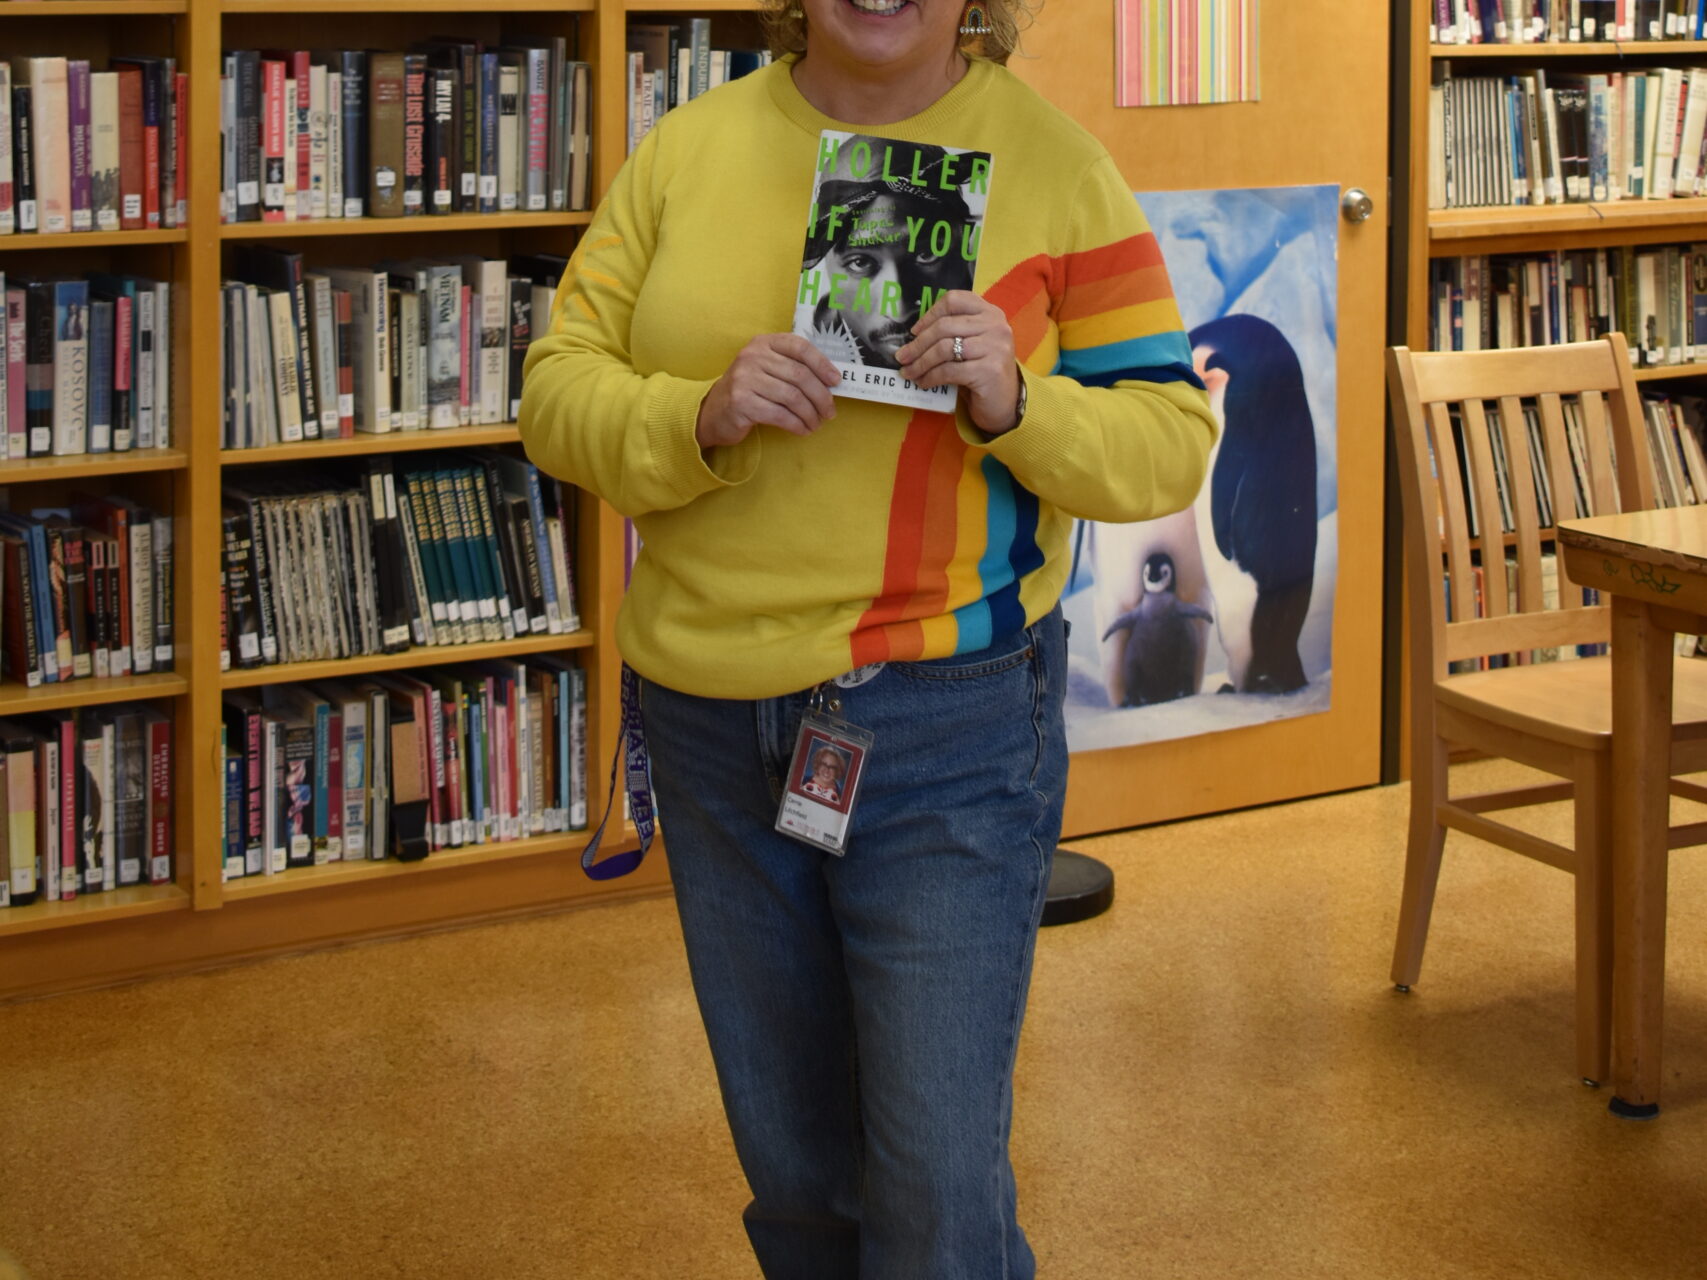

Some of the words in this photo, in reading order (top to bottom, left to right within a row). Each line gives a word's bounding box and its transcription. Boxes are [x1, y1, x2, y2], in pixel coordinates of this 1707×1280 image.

[272, 64, 280, 98] CHARLIE
[406, 72, 424, 95] The
[436, 80, 452, 96] MY
[697, 46, 708, 96] ENDURIN
[406, 97, 424, 122] Lost
[436, 97, 452, 112] LAI
[644, 78, 652, 107] TRAIL
[272, 100, 280, 134] WILSON'S
[528, 93, 548, 171] BACKFIRE
[272, 135, 280, 152] WAR
[406, 125, 424, 176] Crusade
[818, 136, 990, 195] HOLLER
[808, 203, 848, 241] IF
[906, 216, 981, 261] YOU
[296, 283, 306, 327] VIETNAM
[377, 278, 386, 332] Homecoming
[440, 273, 450, 323] VIETNAM
[799, 269, 902, 318] HEAR
[919, 286, 947, 320] M
[10, 320, 25, 339] The
[300, 331, 309, 348] THE
[10, 340, 25, 362] Serbs
[302, 349, 311, 368] WAR
[304, 371, 311, 379] IN
[305, 380, 313, 397] THE
[865, 373, 896, 387] ERIC
[522, 519, 534, 552] AMERICA
[528, 562, 541, 597] VIETNAM
[248, 714, 261, 789] EVERYTHING
[533, 721, 542, 758] BLACK
[152, 754, 160, 788] DEFEAT
[160, 743, 168, 797] EMBRACING
[435, 742, 443, 782] SUDAN
[248, 790, 261, 809] WE
[248, 811, 261, 837] HAD
